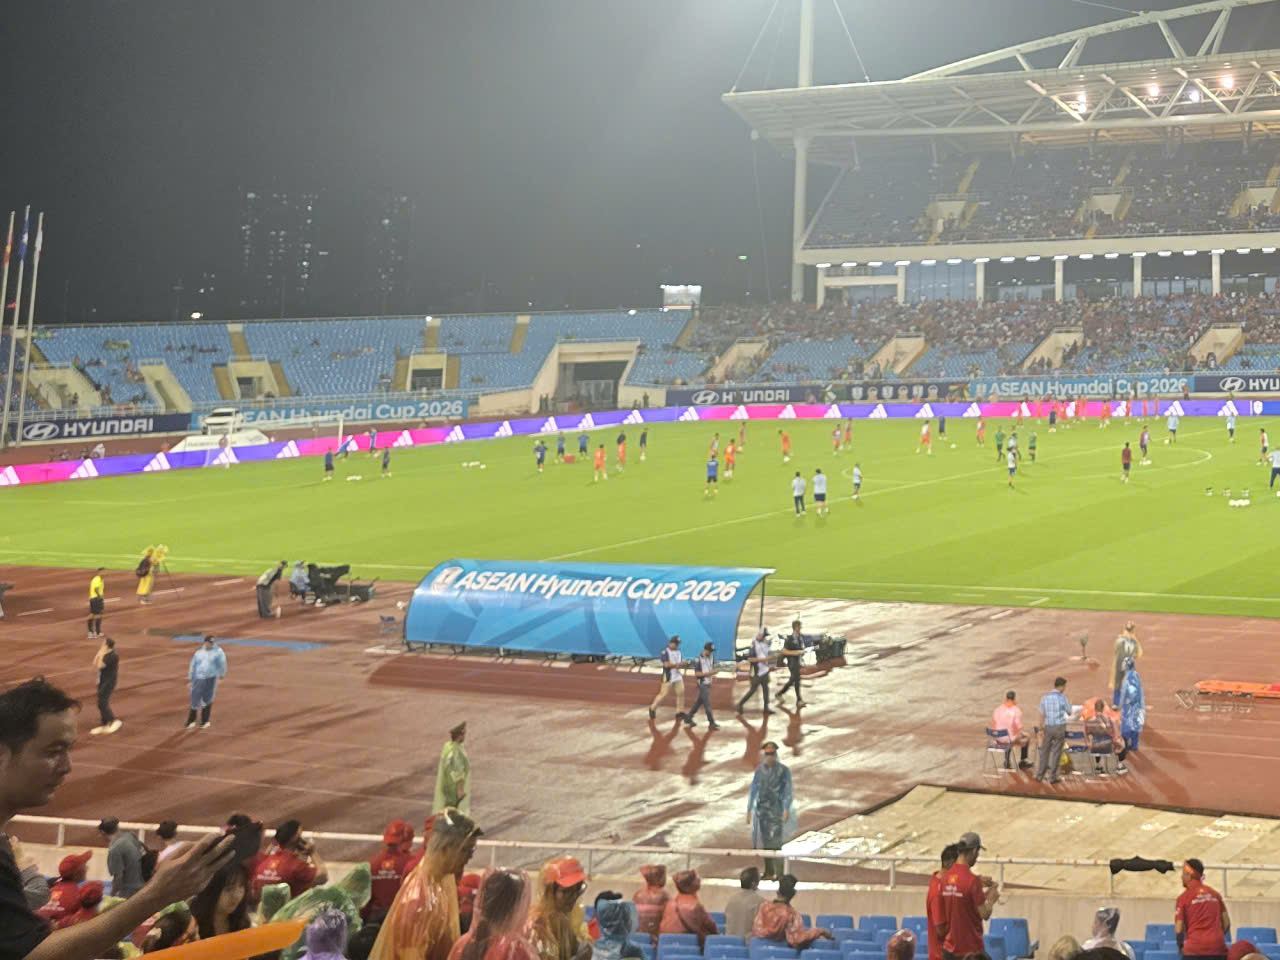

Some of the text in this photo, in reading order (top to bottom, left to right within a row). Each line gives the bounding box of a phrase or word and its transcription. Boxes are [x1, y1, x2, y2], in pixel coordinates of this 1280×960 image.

[989, 381, 1045, 396] ASEAN
[1047, 379, 1114, 396] Hyundai
[376, 404, 415, 424] Cup
[417, 400, 463, 418] 2026
[63, 418, 154, 437] HYUNDAI
[453, 570, 740, 602] ASEAN Hyundai Cup 2026
